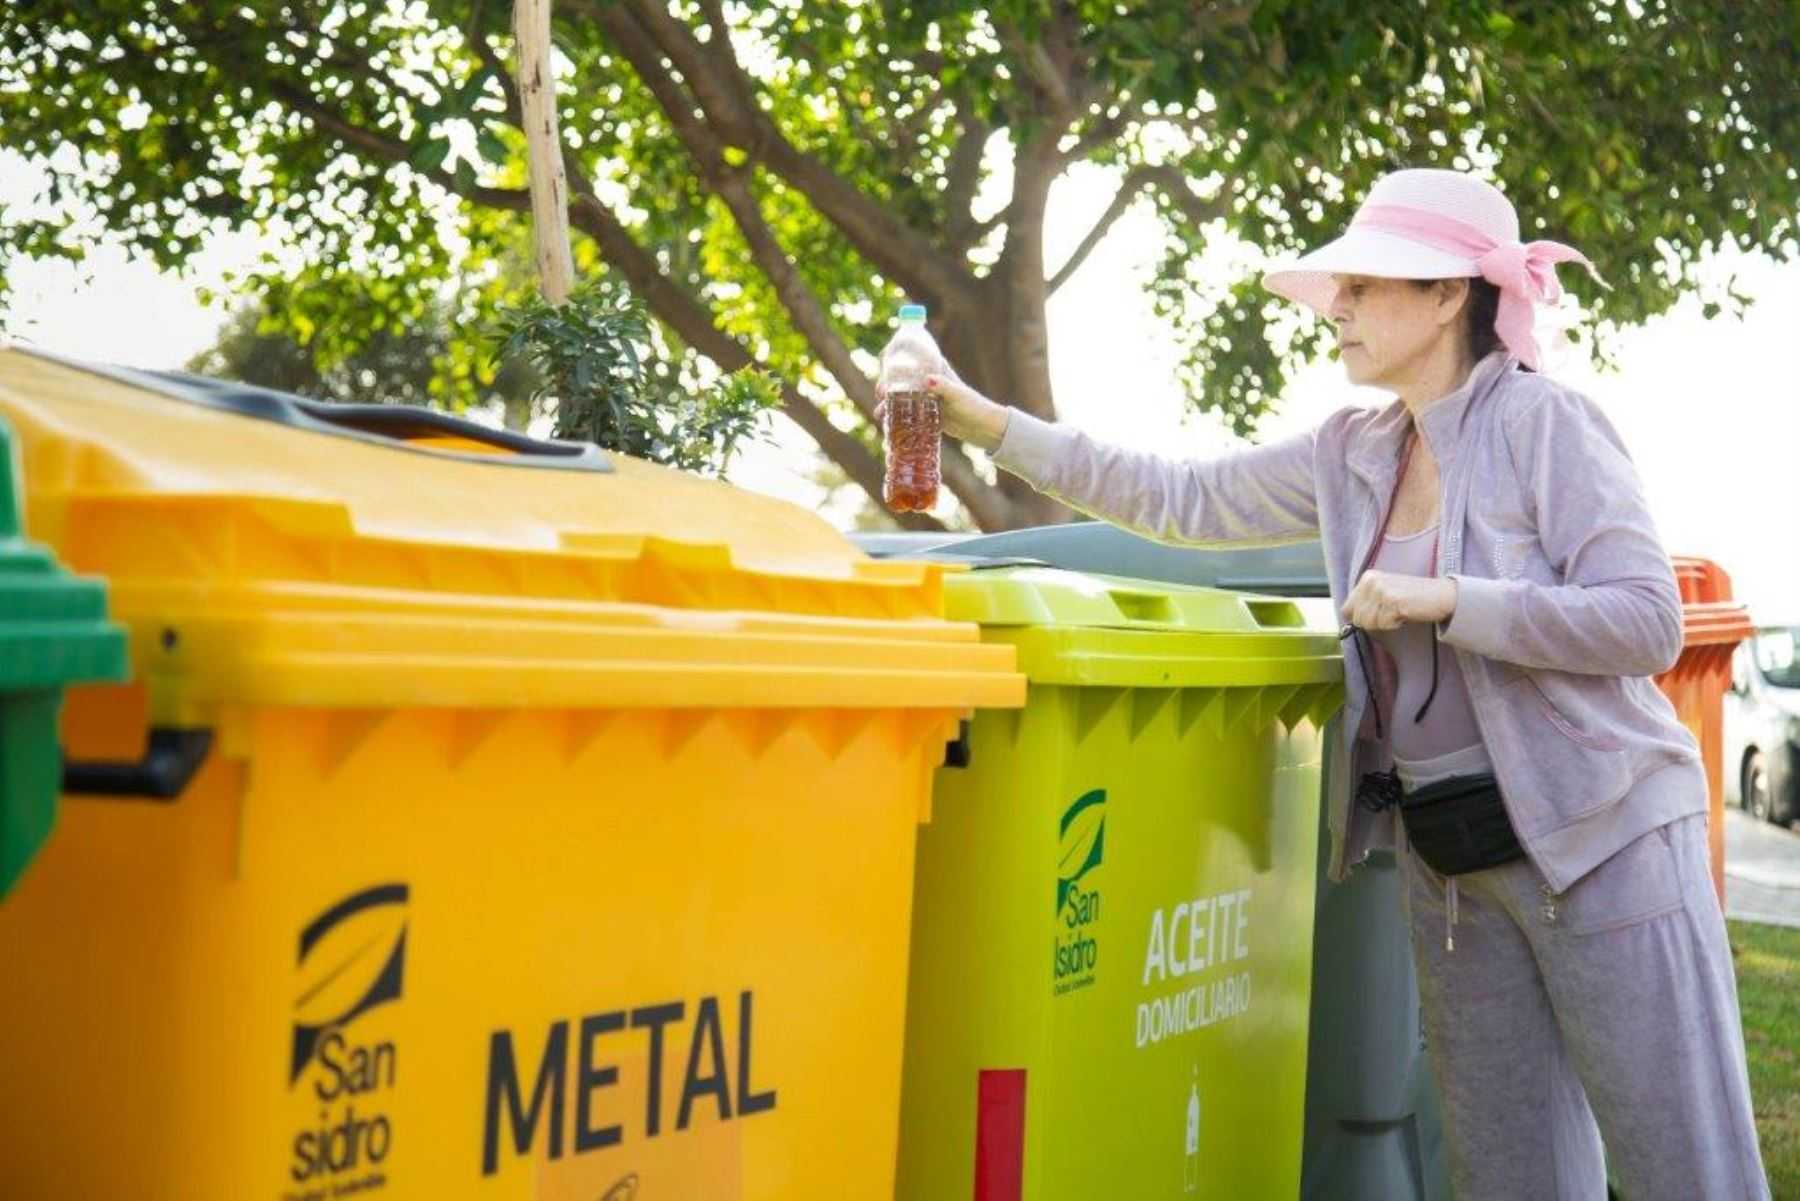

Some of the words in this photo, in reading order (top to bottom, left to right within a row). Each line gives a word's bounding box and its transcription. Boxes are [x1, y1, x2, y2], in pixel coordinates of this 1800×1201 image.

[1065, 884, 1099, 928] San
[1142, 889, 1251, 985] ACEITE
[1054, 931, 1097, 980] Isidro
[1136, 971, 1250, 1048] DOMICILIARIO
[314, 1031, 396, 1102] San
[481, 990, 777, 1177] METAL
